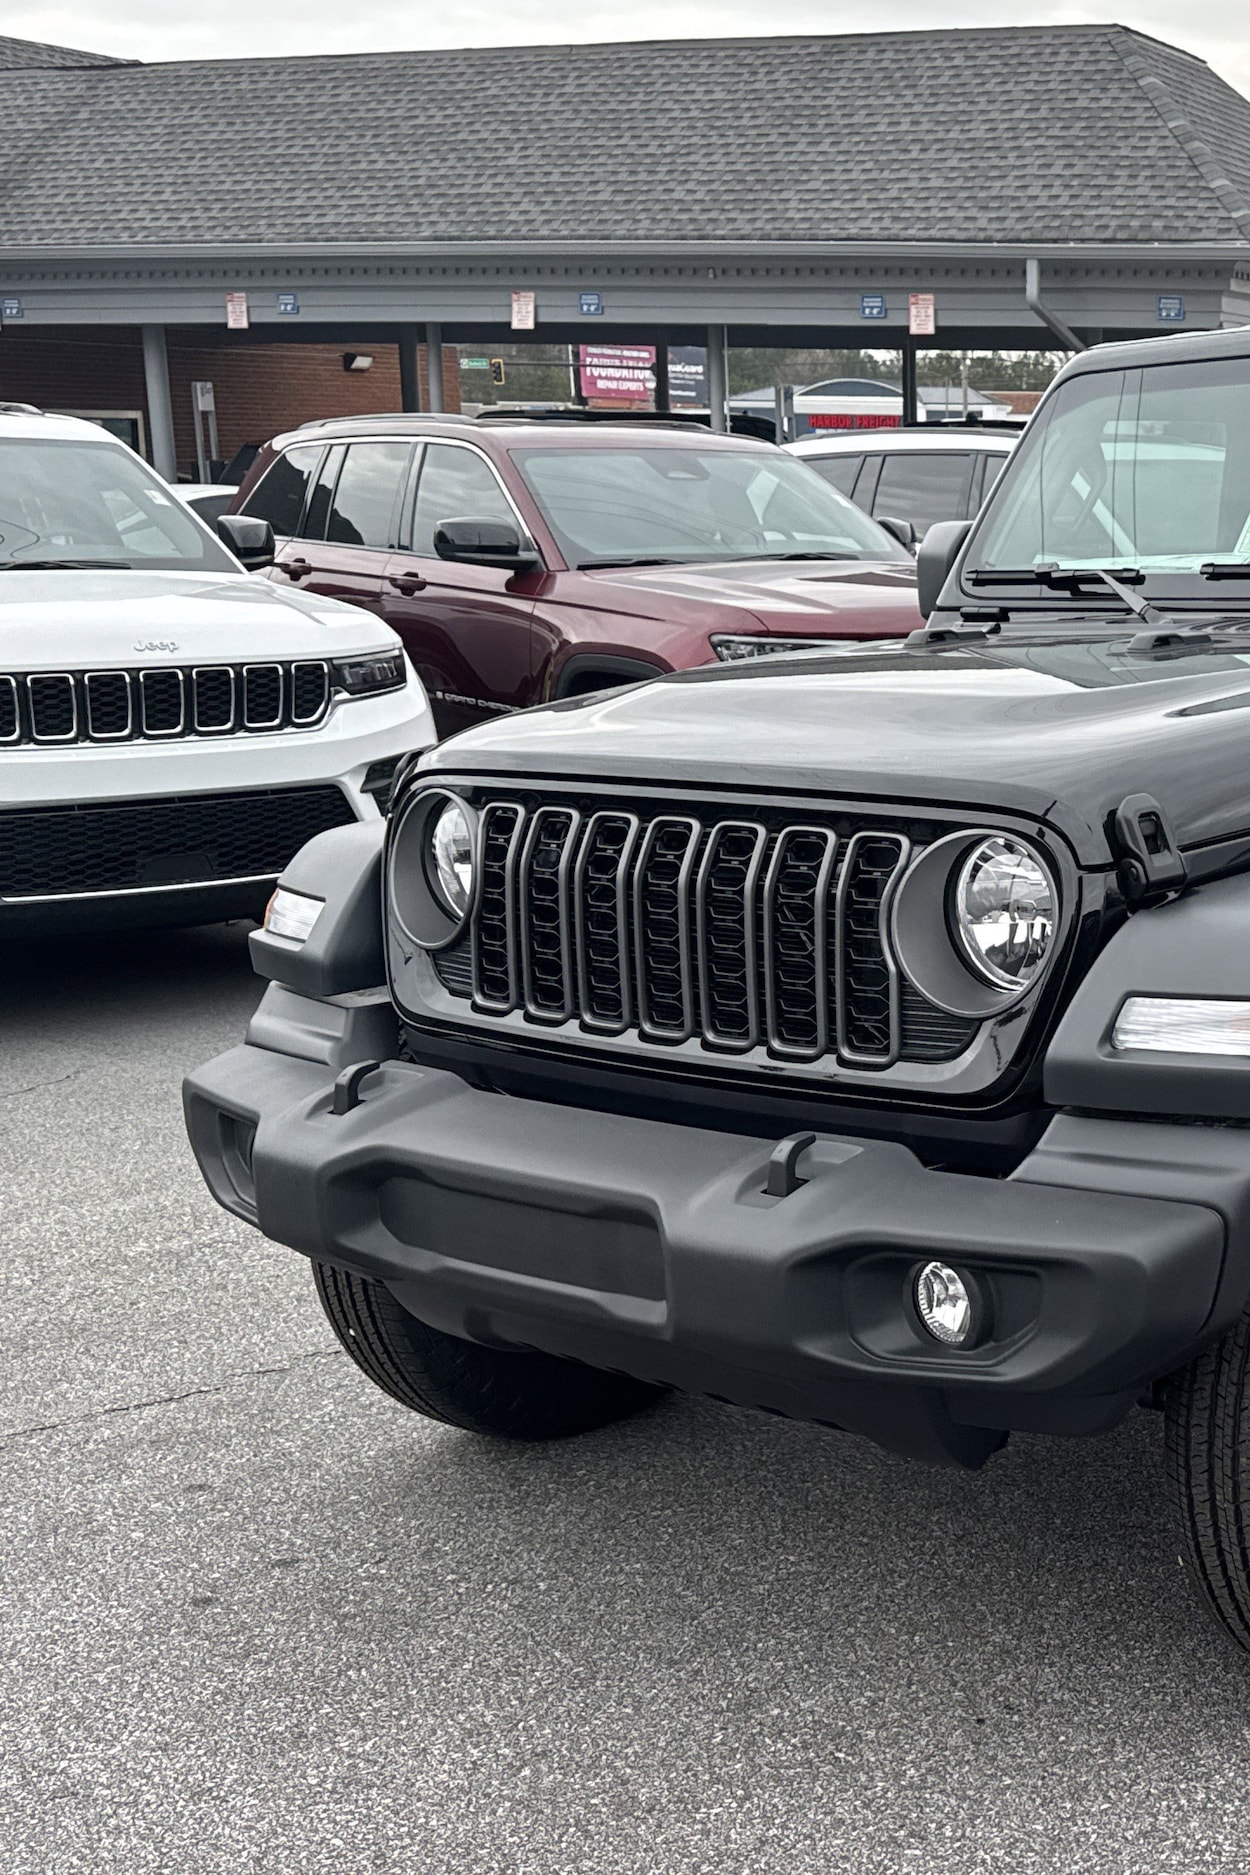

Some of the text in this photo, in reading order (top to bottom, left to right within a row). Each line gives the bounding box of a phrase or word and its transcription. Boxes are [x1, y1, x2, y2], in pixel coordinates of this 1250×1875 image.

[585, 357, 651, 379] FOUNDATION
[618, 380, 645, 392] EXPERTS
[808, 414, 900, 429] HARBOR FREIGHT
[133, 639, 179, 653] Jeep
